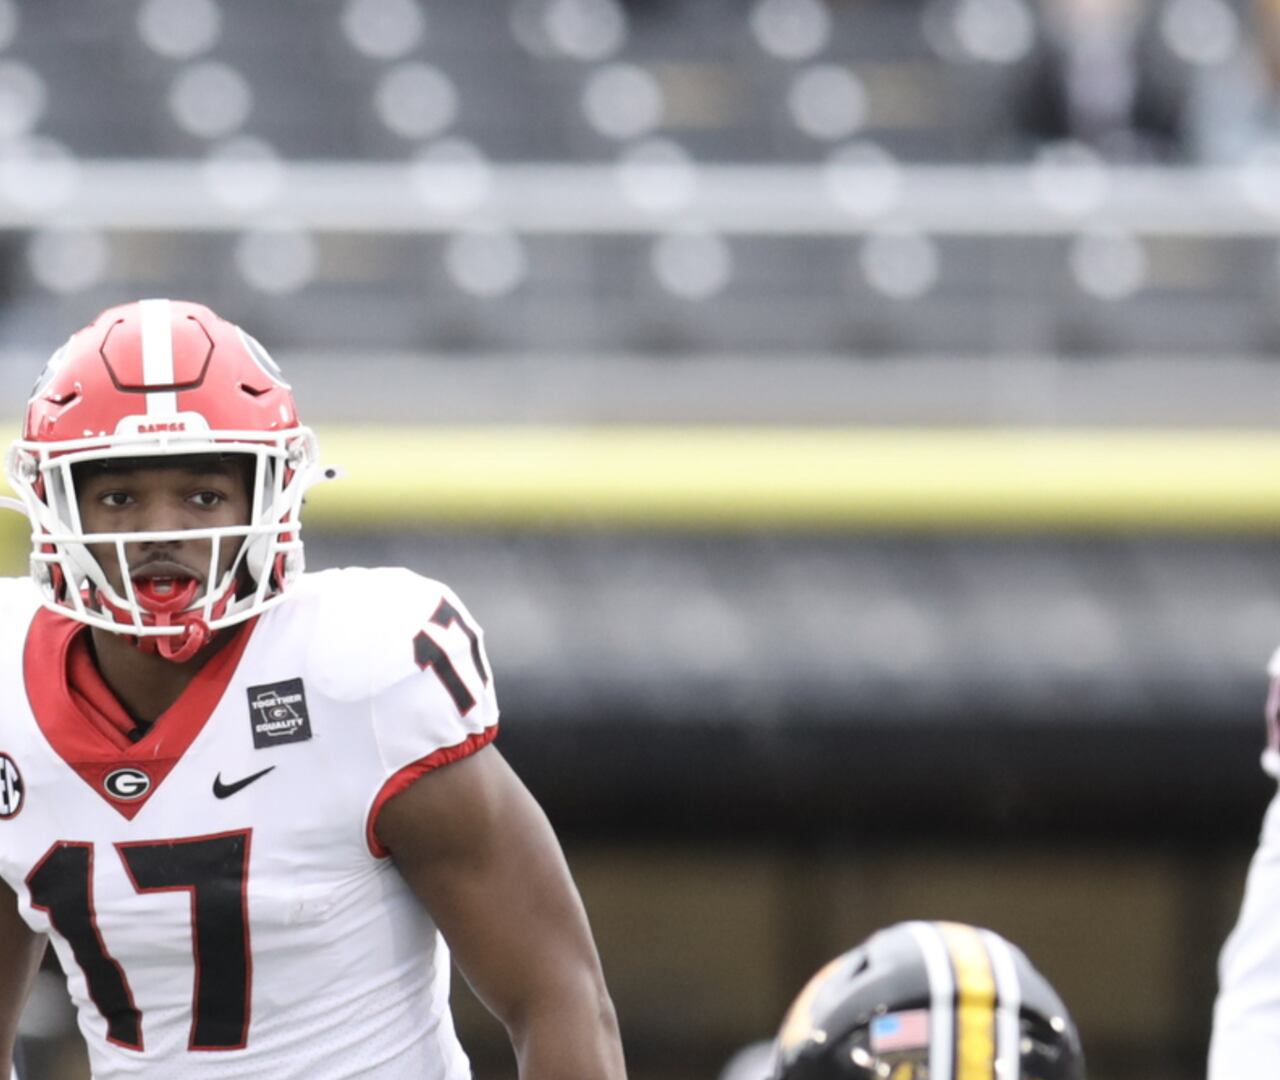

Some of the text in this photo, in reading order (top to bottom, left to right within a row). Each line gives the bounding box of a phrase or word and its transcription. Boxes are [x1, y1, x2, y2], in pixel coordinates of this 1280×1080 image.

[412, 595, 489, 718] 17
[251, 693, 302, 710] TOGETHER
[255, 718, 303, 733] EQUALITY
[104, 768, 151, 800] G
[24, 826, 253, 1053] 17
